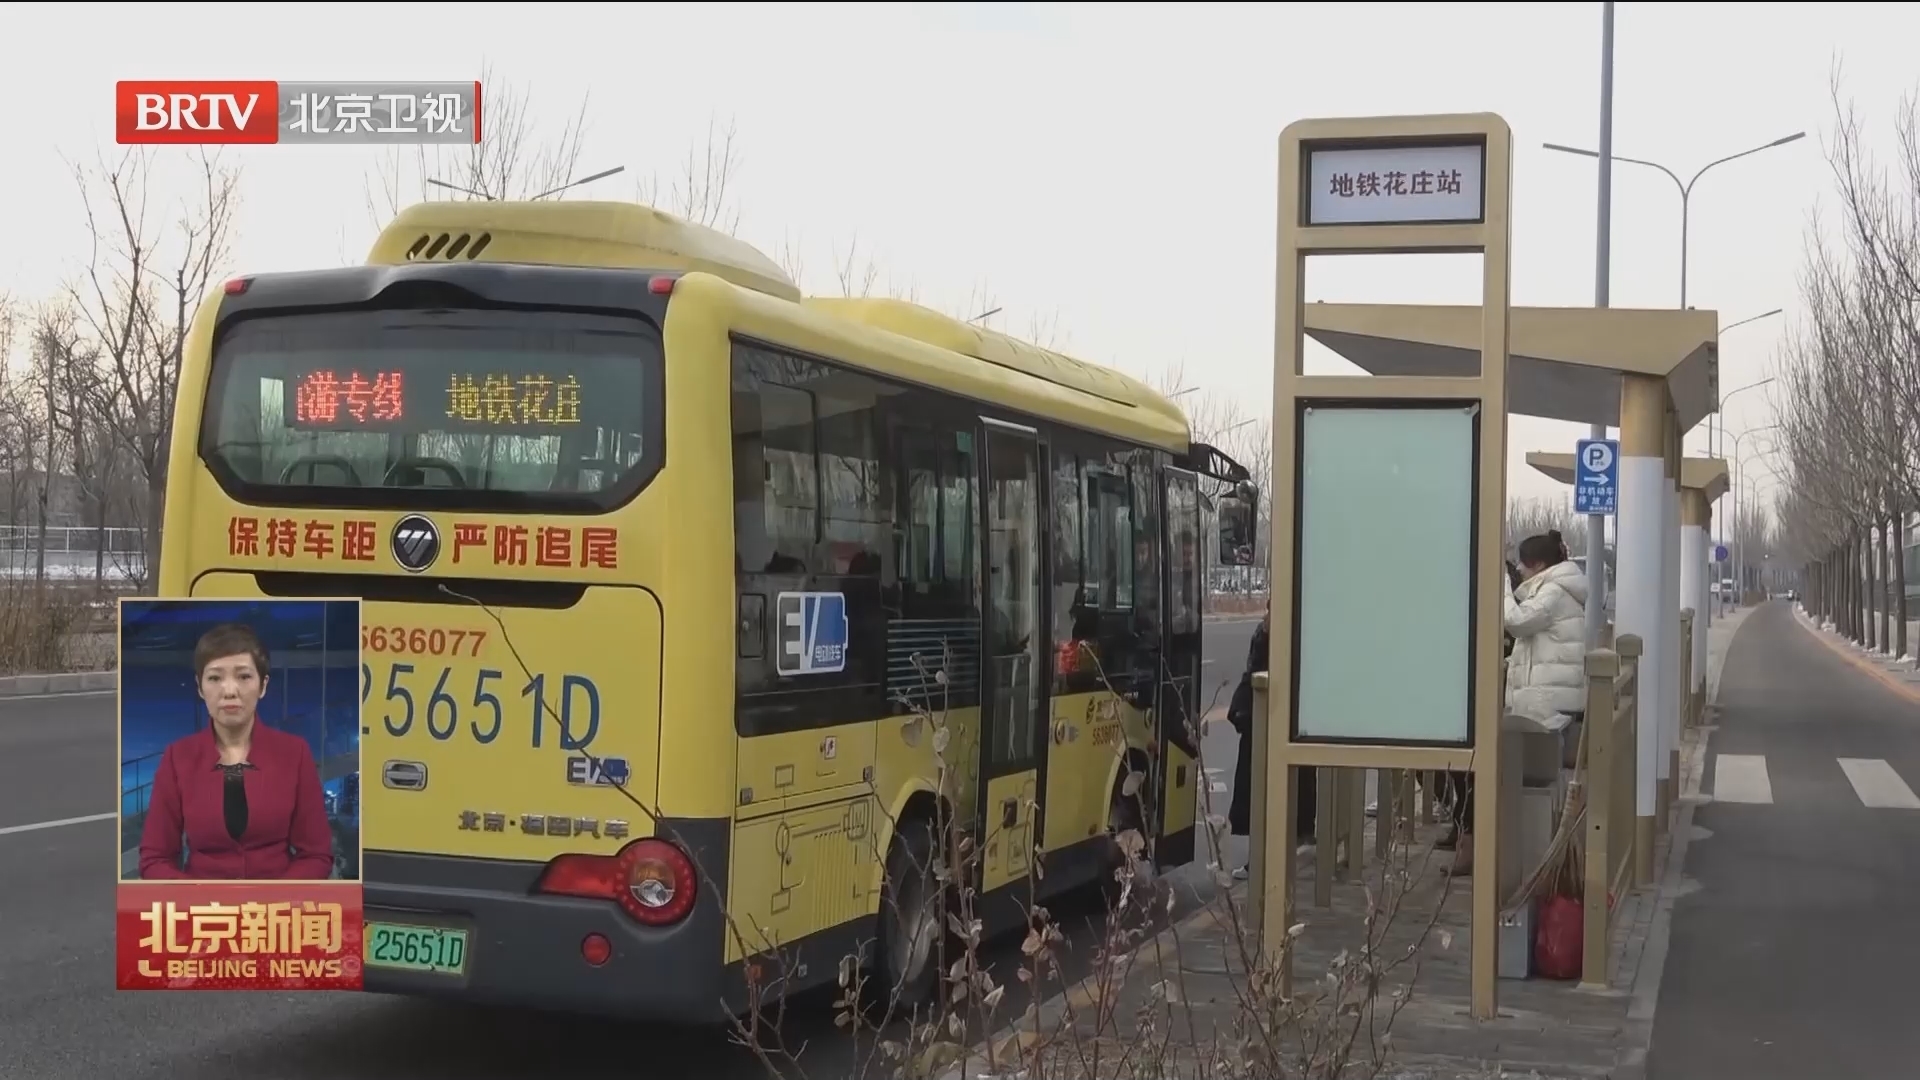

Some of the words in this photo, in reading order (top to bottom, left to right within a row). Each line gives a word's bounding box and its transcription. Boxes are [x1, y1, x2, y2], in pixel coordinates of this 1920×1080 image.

[1330, 168, 1462, 198] 地铁花庄站
[445, 373, 581, 424] 地铁花庄
[1589, 448, 1604, 467] P
[228, 516, 377, 561] 保持车距
[452, 523, 619, 569] 严防追尾
[374, 930, 464, 967] 25651D
